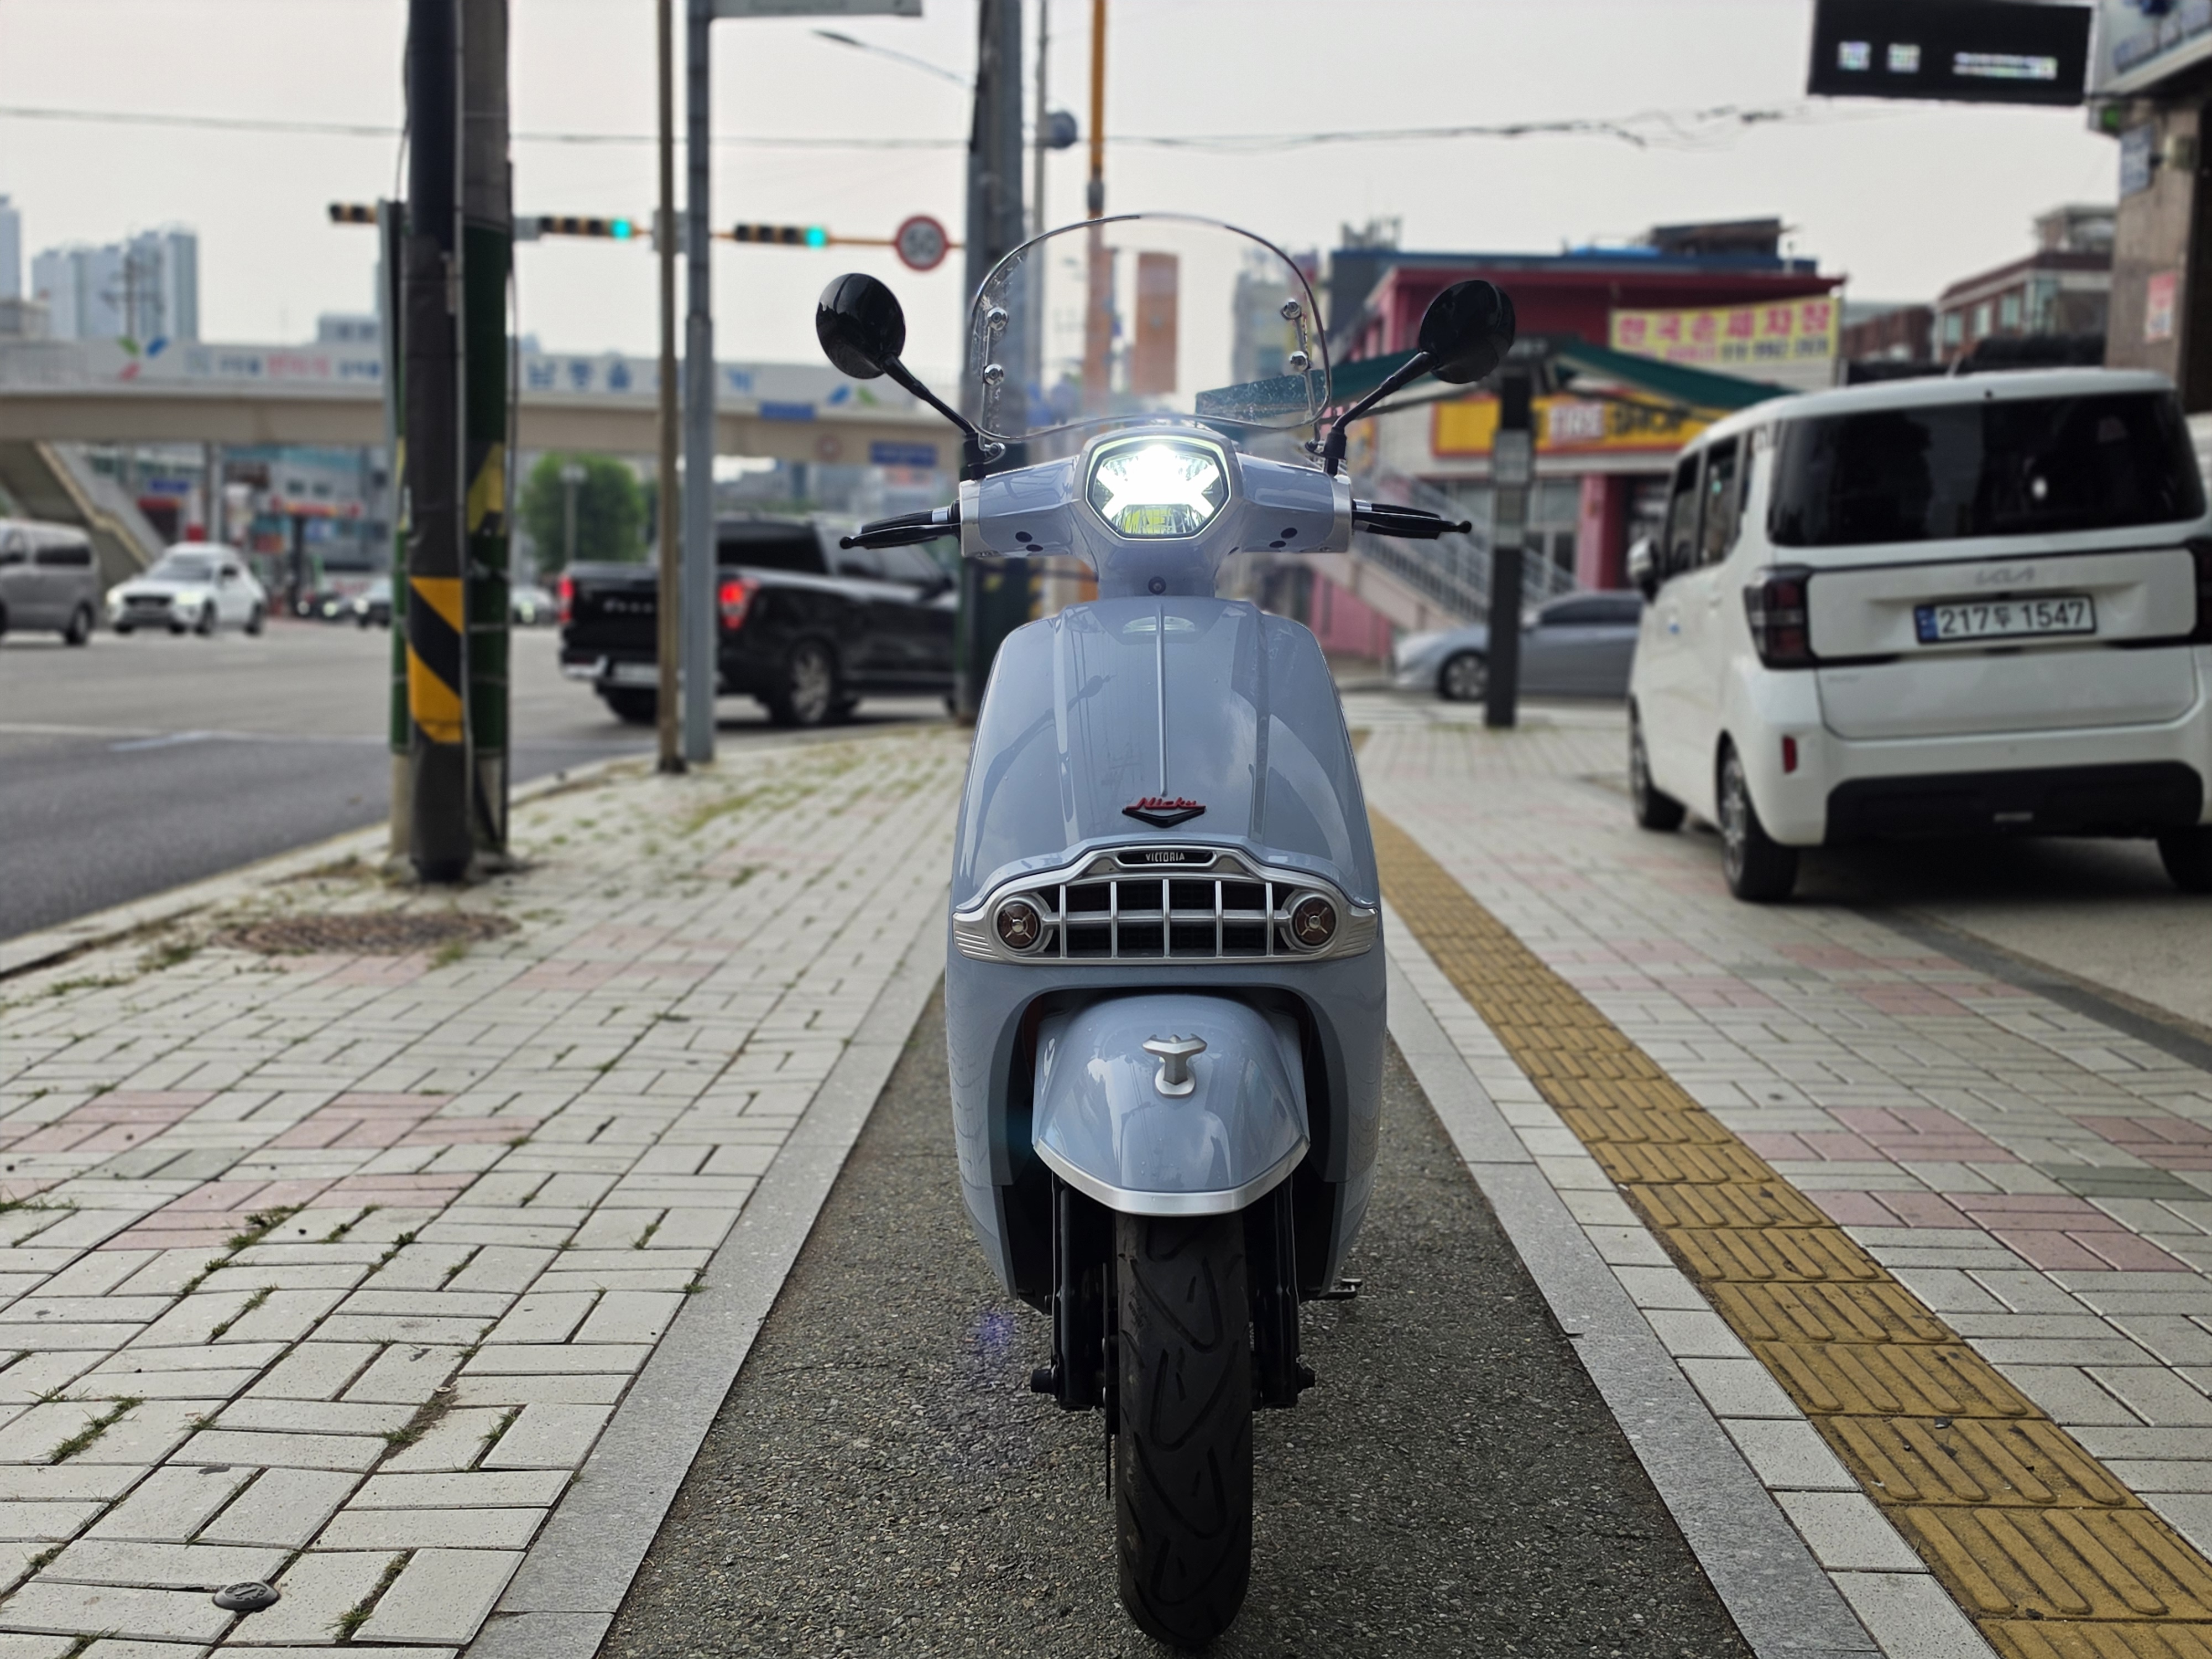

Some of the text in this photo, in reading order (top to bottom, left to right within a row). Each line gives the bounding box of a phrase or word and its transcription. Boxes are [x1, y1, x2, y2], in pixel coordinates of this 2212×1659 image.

[1548, 399, 1604, 441] TIRE
[2021, 600, 2085, 629] 1547
[1145, 852, 1185, 862] VICTORIA
